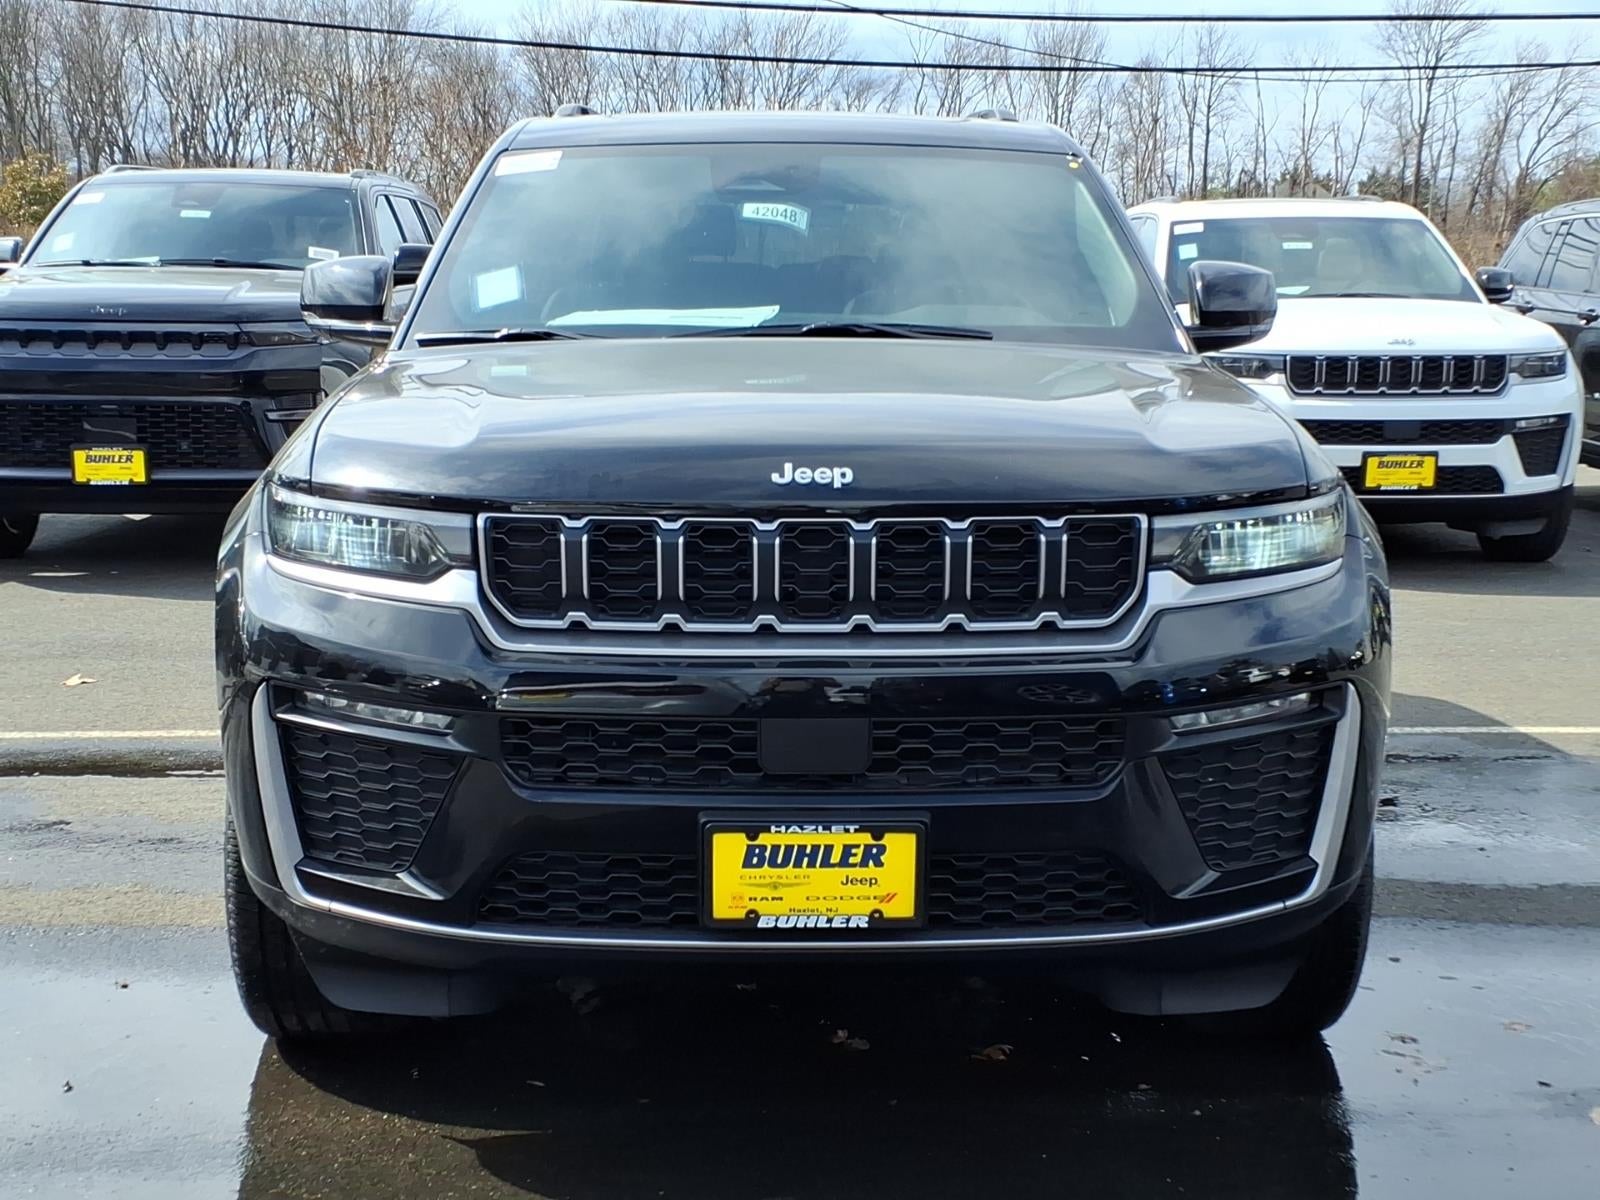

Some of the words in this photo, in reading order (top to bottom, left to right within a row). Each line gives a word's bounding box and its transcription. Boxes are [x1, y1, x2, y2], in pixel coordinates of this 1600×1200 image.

[752, 206, 797, 223] 42048
[86, 455, 133, 463] BUHLER
[1377, 460, 1424, 469] BUHLER
[771, 462, 853, 488] Jeep
[770, 825, 859, 833] HAZLET
[741, 844, 887, 869] BUHLER
[840, 875, 878, 887] Jeep
[757, 915, 869, 928] BUHLER
